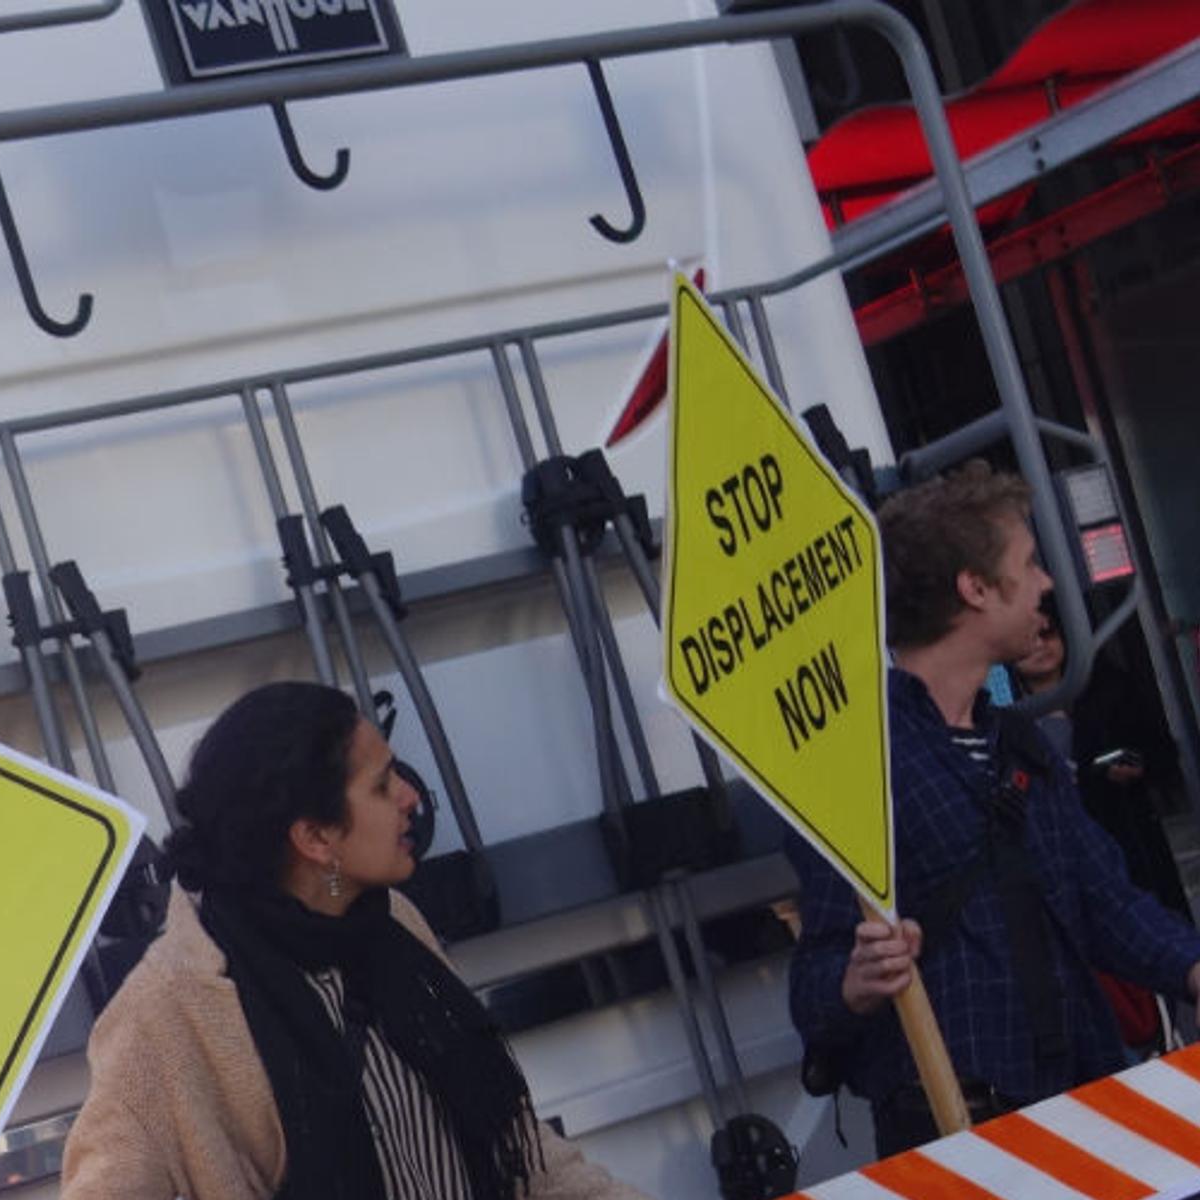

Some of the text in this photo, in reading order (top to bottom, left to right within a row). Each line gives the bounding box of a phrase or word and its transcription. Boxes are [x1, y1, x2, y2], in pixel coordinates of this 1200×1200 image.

[705, 453, 783, 557] STOP
[680, 516, 863, 695] DISPLACEMENT
[774, 641, 849, 752] NOW
